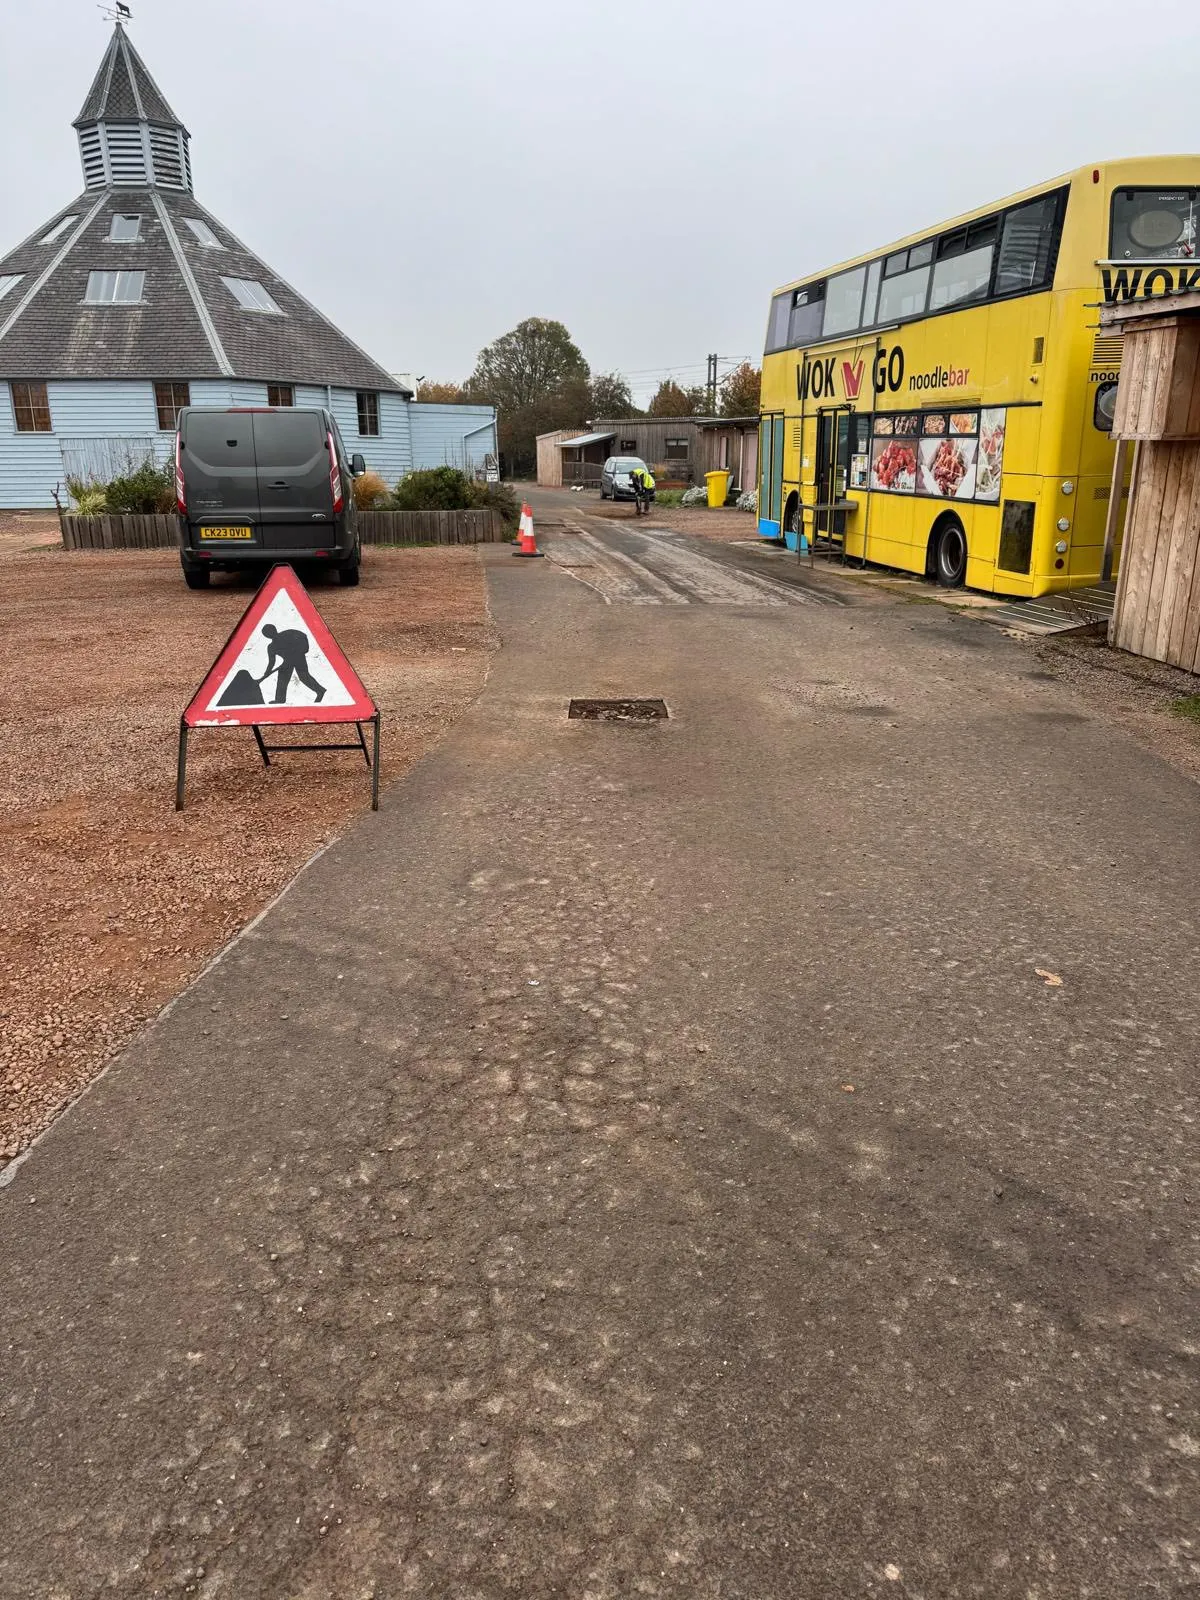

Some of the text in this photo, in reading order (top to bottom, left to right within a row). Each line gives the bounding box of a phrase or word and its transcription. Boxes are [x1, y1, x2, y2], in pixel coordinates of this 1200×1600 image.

[796, 357, 836, 401] WOK
[872, 345, 905, 393] GO
[909, 364, 970, 391] noodlebar
[204, 528, 247, 537] CK23 OVU
